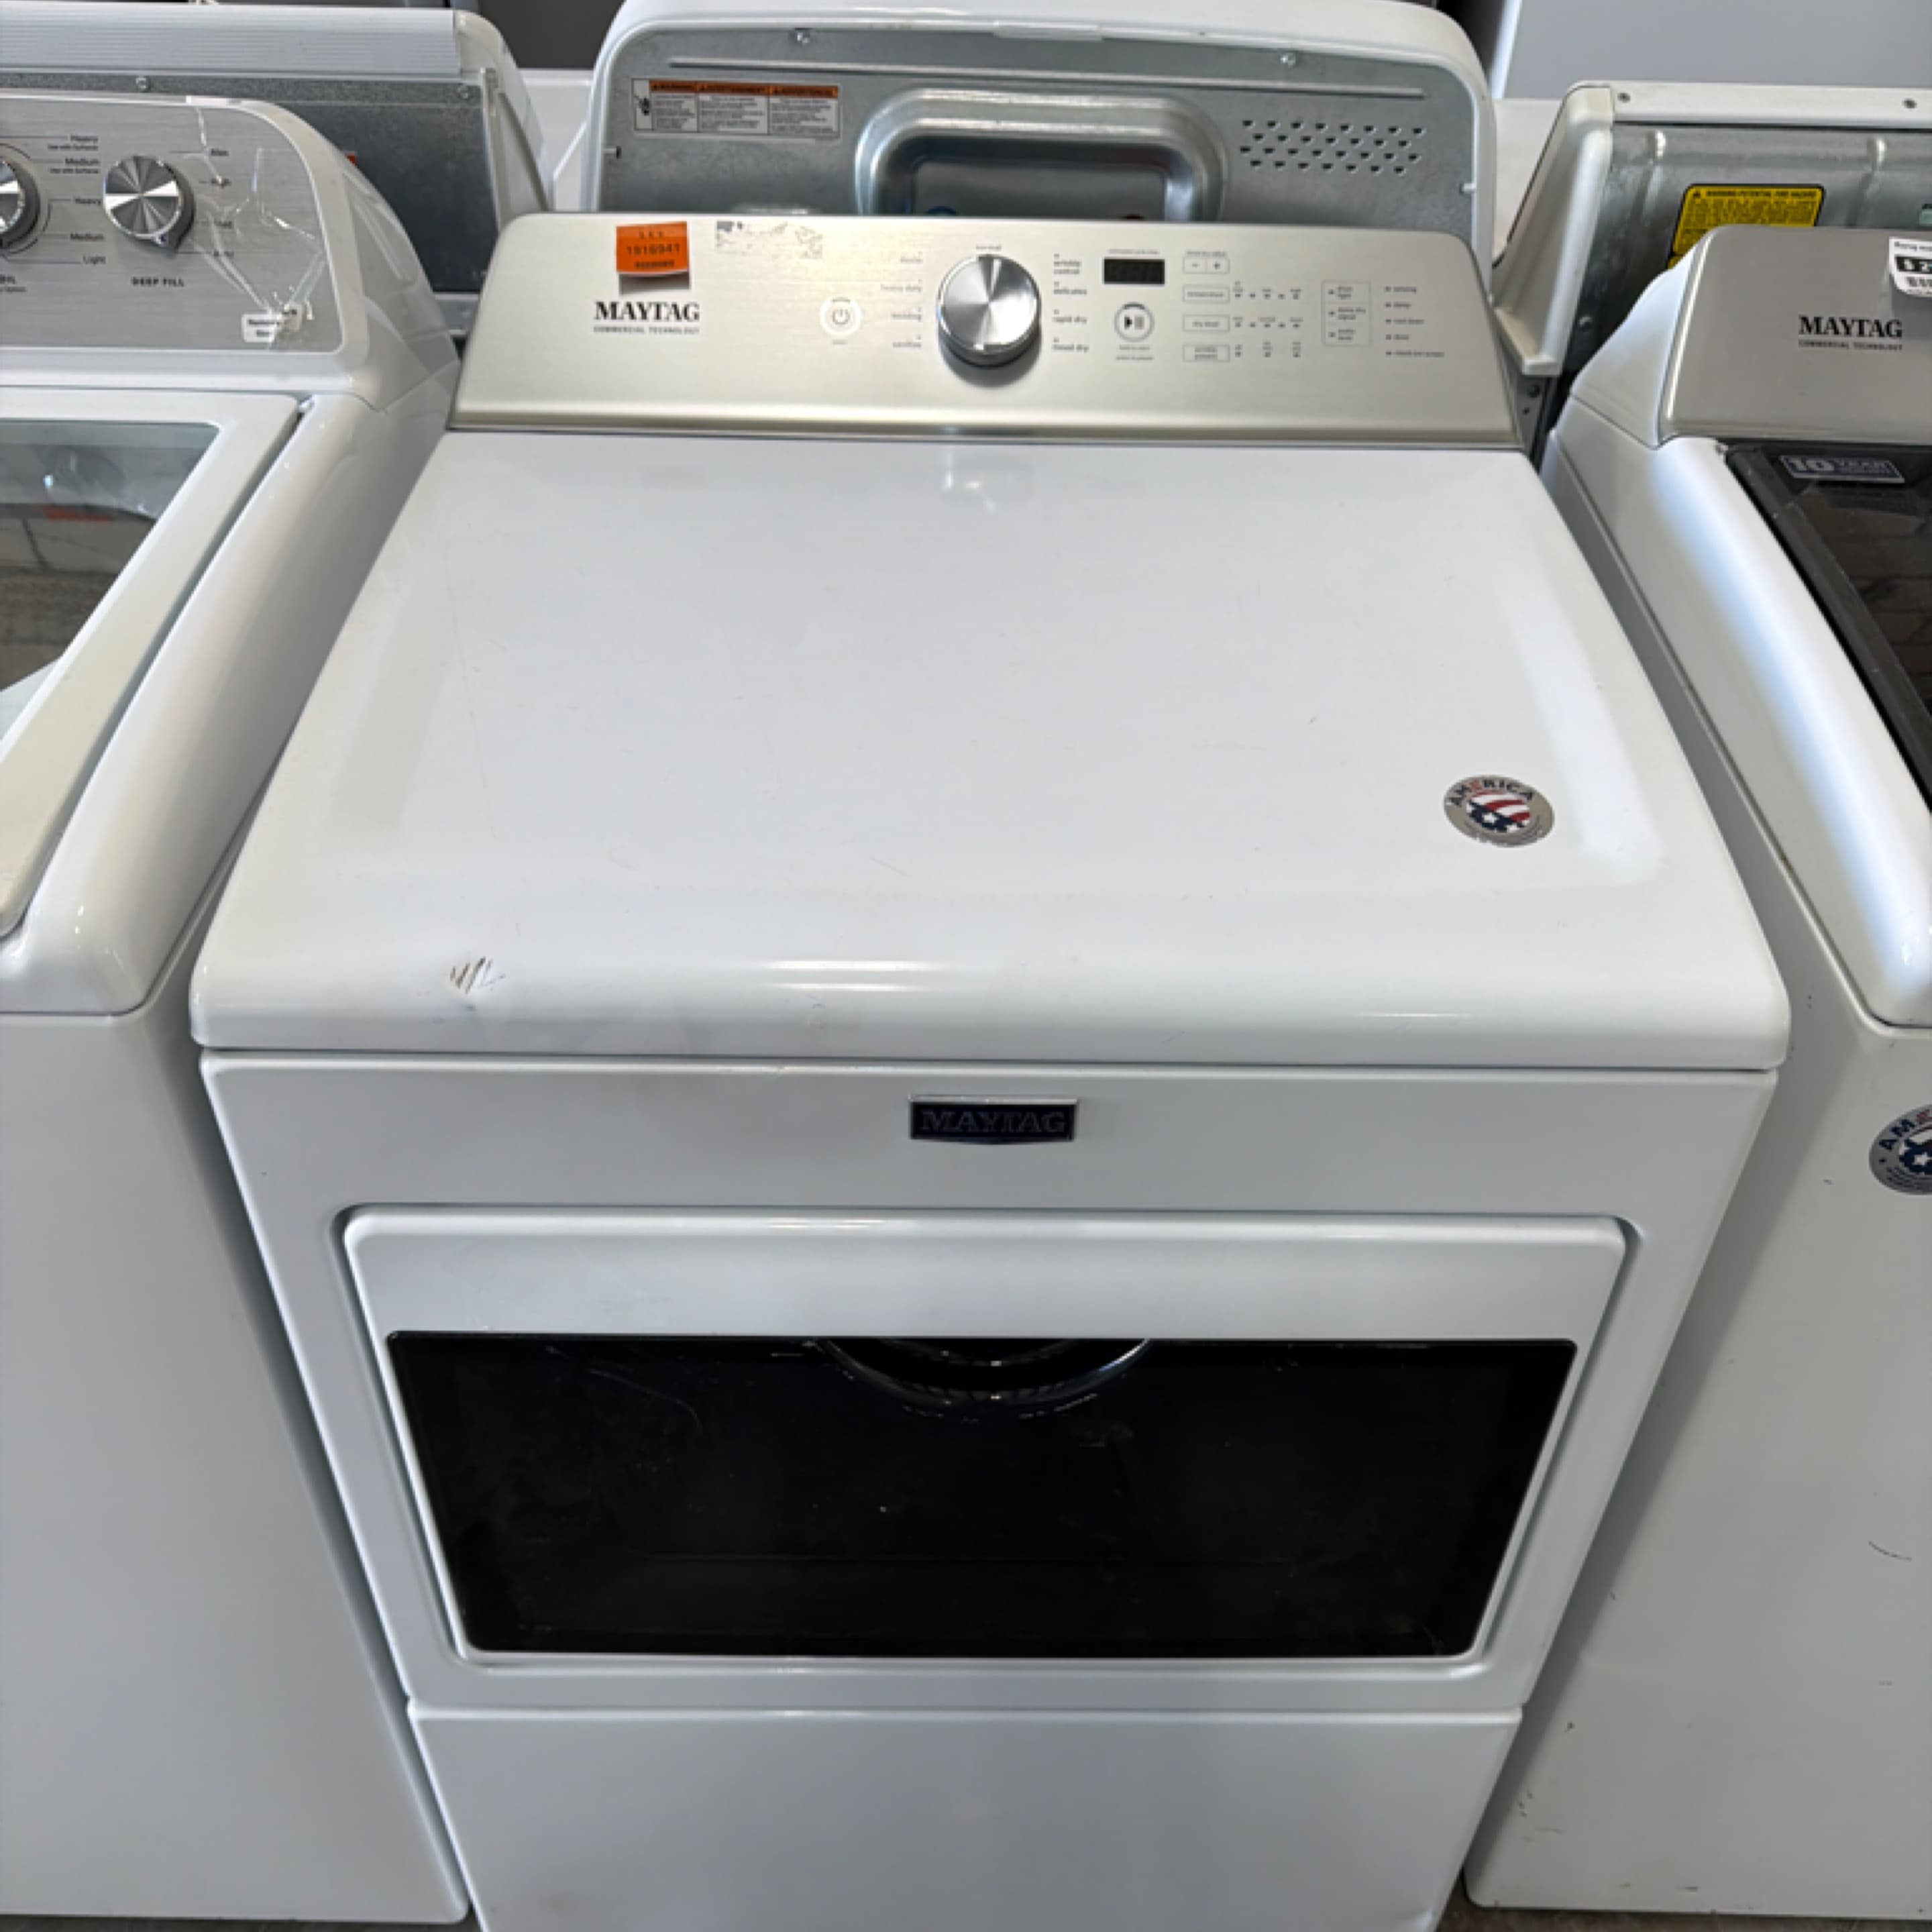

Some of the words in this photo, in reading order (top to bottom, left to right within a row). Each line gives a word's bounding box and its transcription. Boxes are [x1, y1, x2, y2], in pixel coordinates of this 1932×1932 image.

[131, 276, 160, 286] DEEP
[162, 276, 184, 287] FILL
[594, 301, 700, 322] MAYTAG
[1799, 314, 1903, 338] MAYTAG
[1446, 779, 1534, 807] AMERICA
[920, 1110, 1067, 1134] MAYTAG
